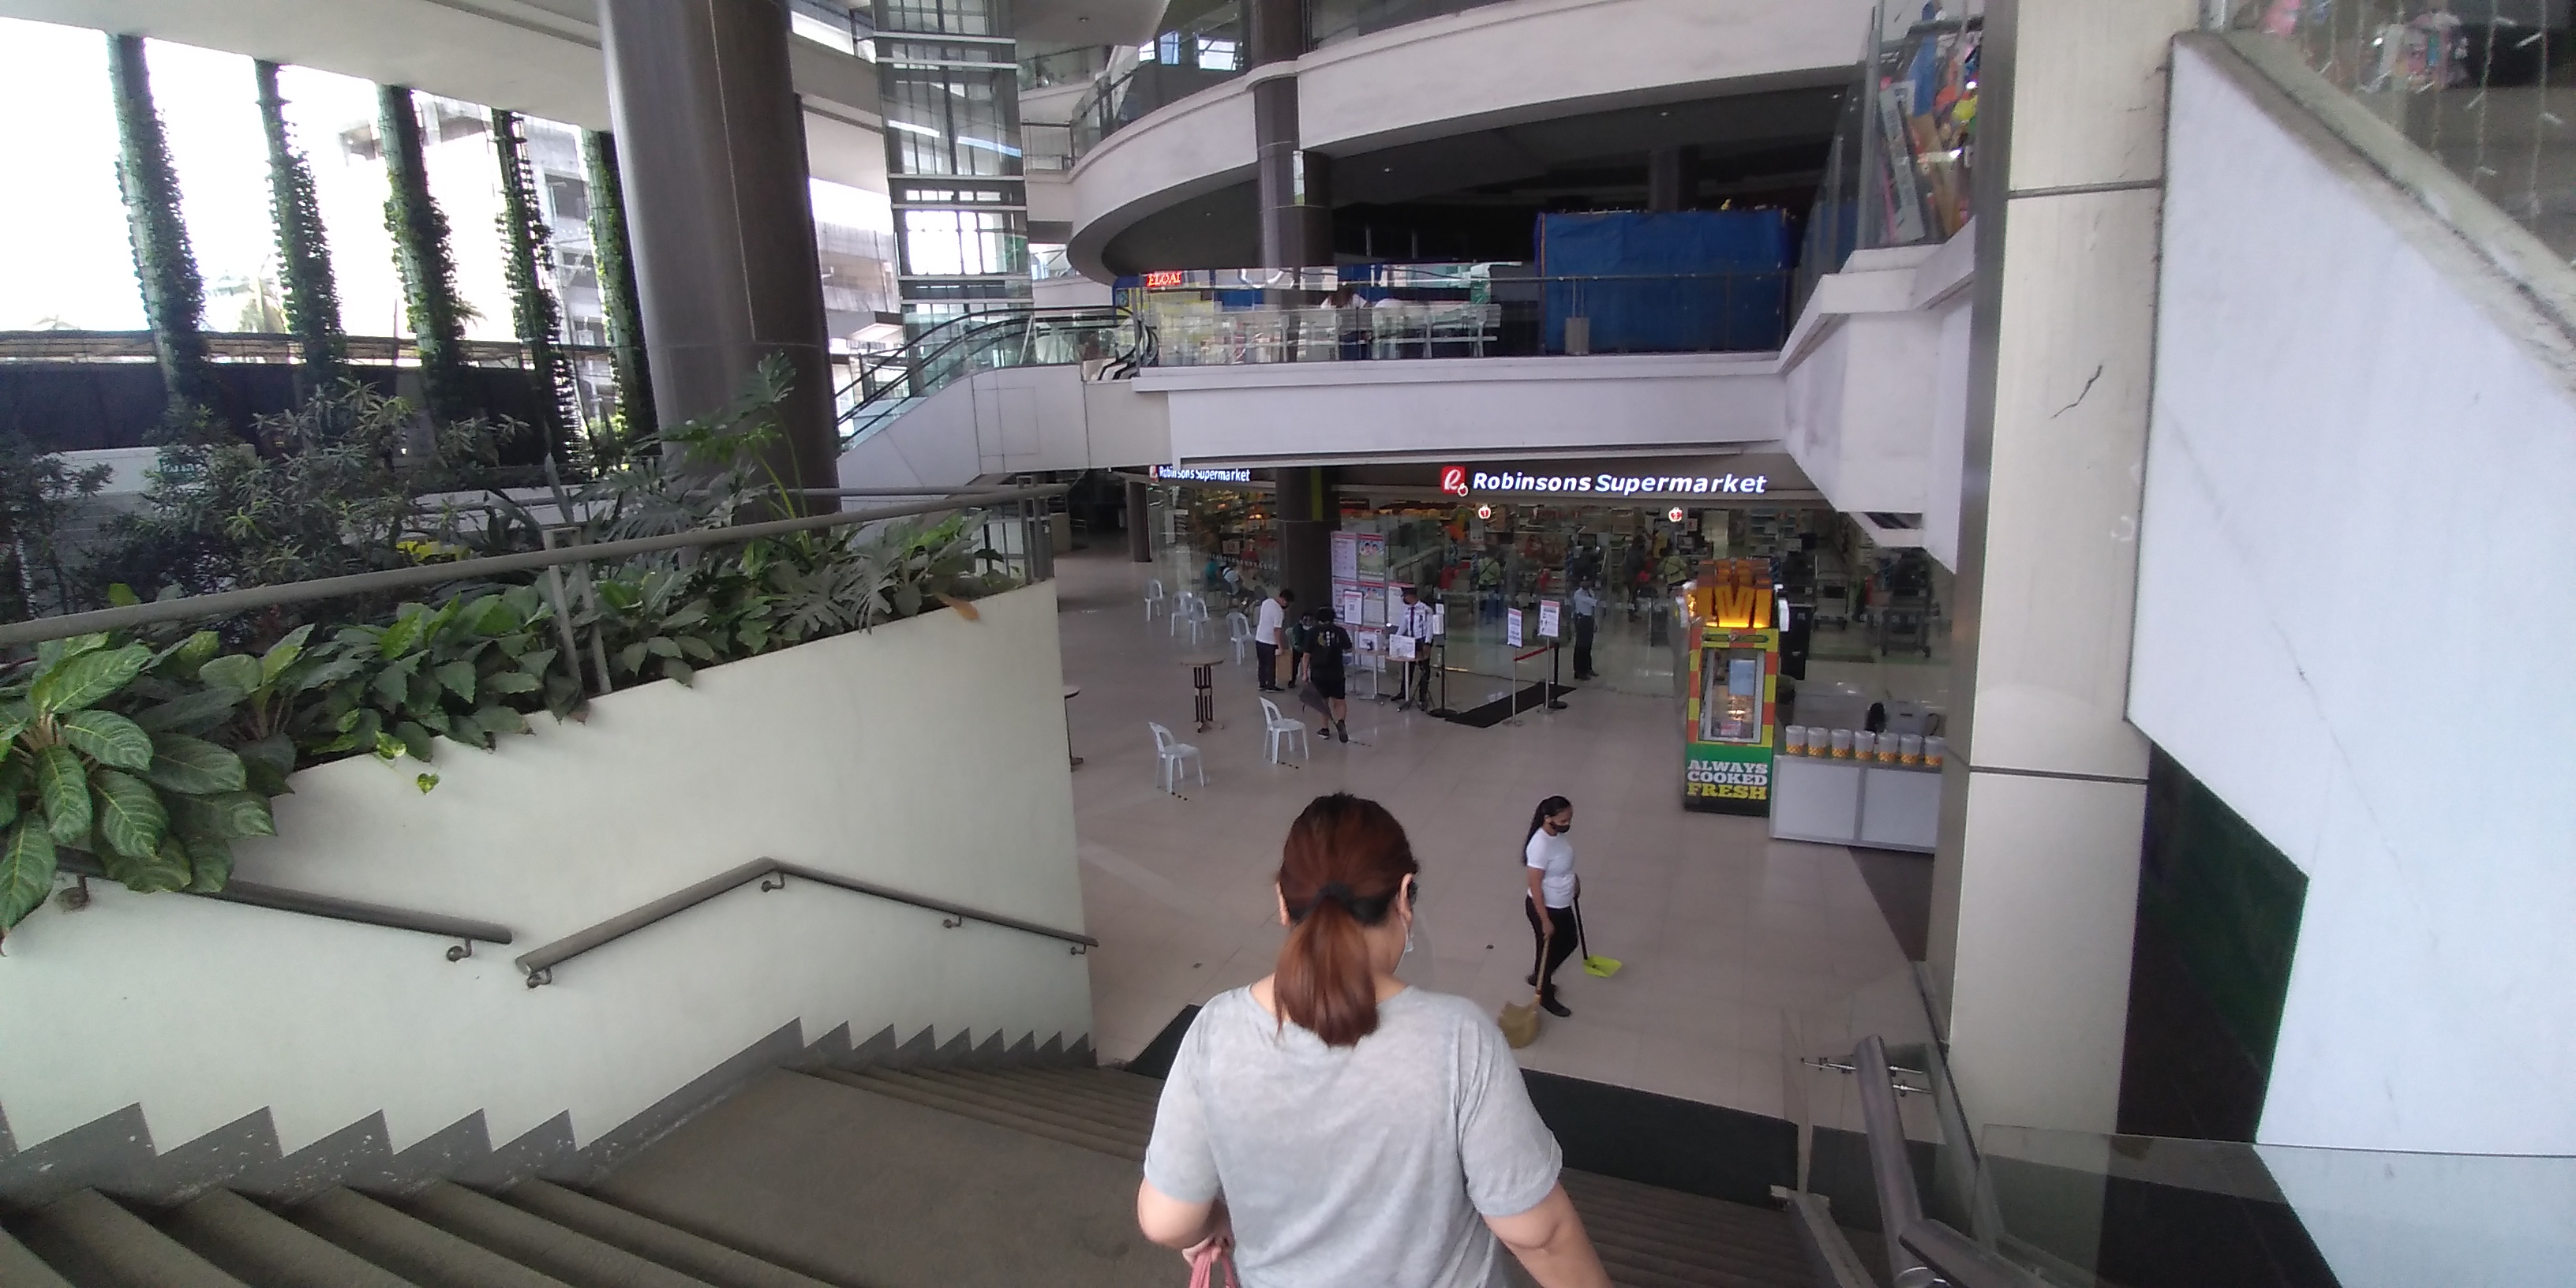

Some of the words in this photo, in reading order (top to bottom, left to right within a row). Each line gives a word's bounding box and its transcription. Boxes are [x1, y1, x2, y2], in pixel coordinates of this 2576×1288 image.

[1196, 469, 1250, 481] Supermarket
[1473, 471, 1592, 492] Robinsons
[1594, 473, 1768, 496] Supermarket
[1688, 760, 1768, 773] ALWAYS
[1687, 771, 1768, 785] COOKED
[1687, 781, 1766, 799] FRESH
